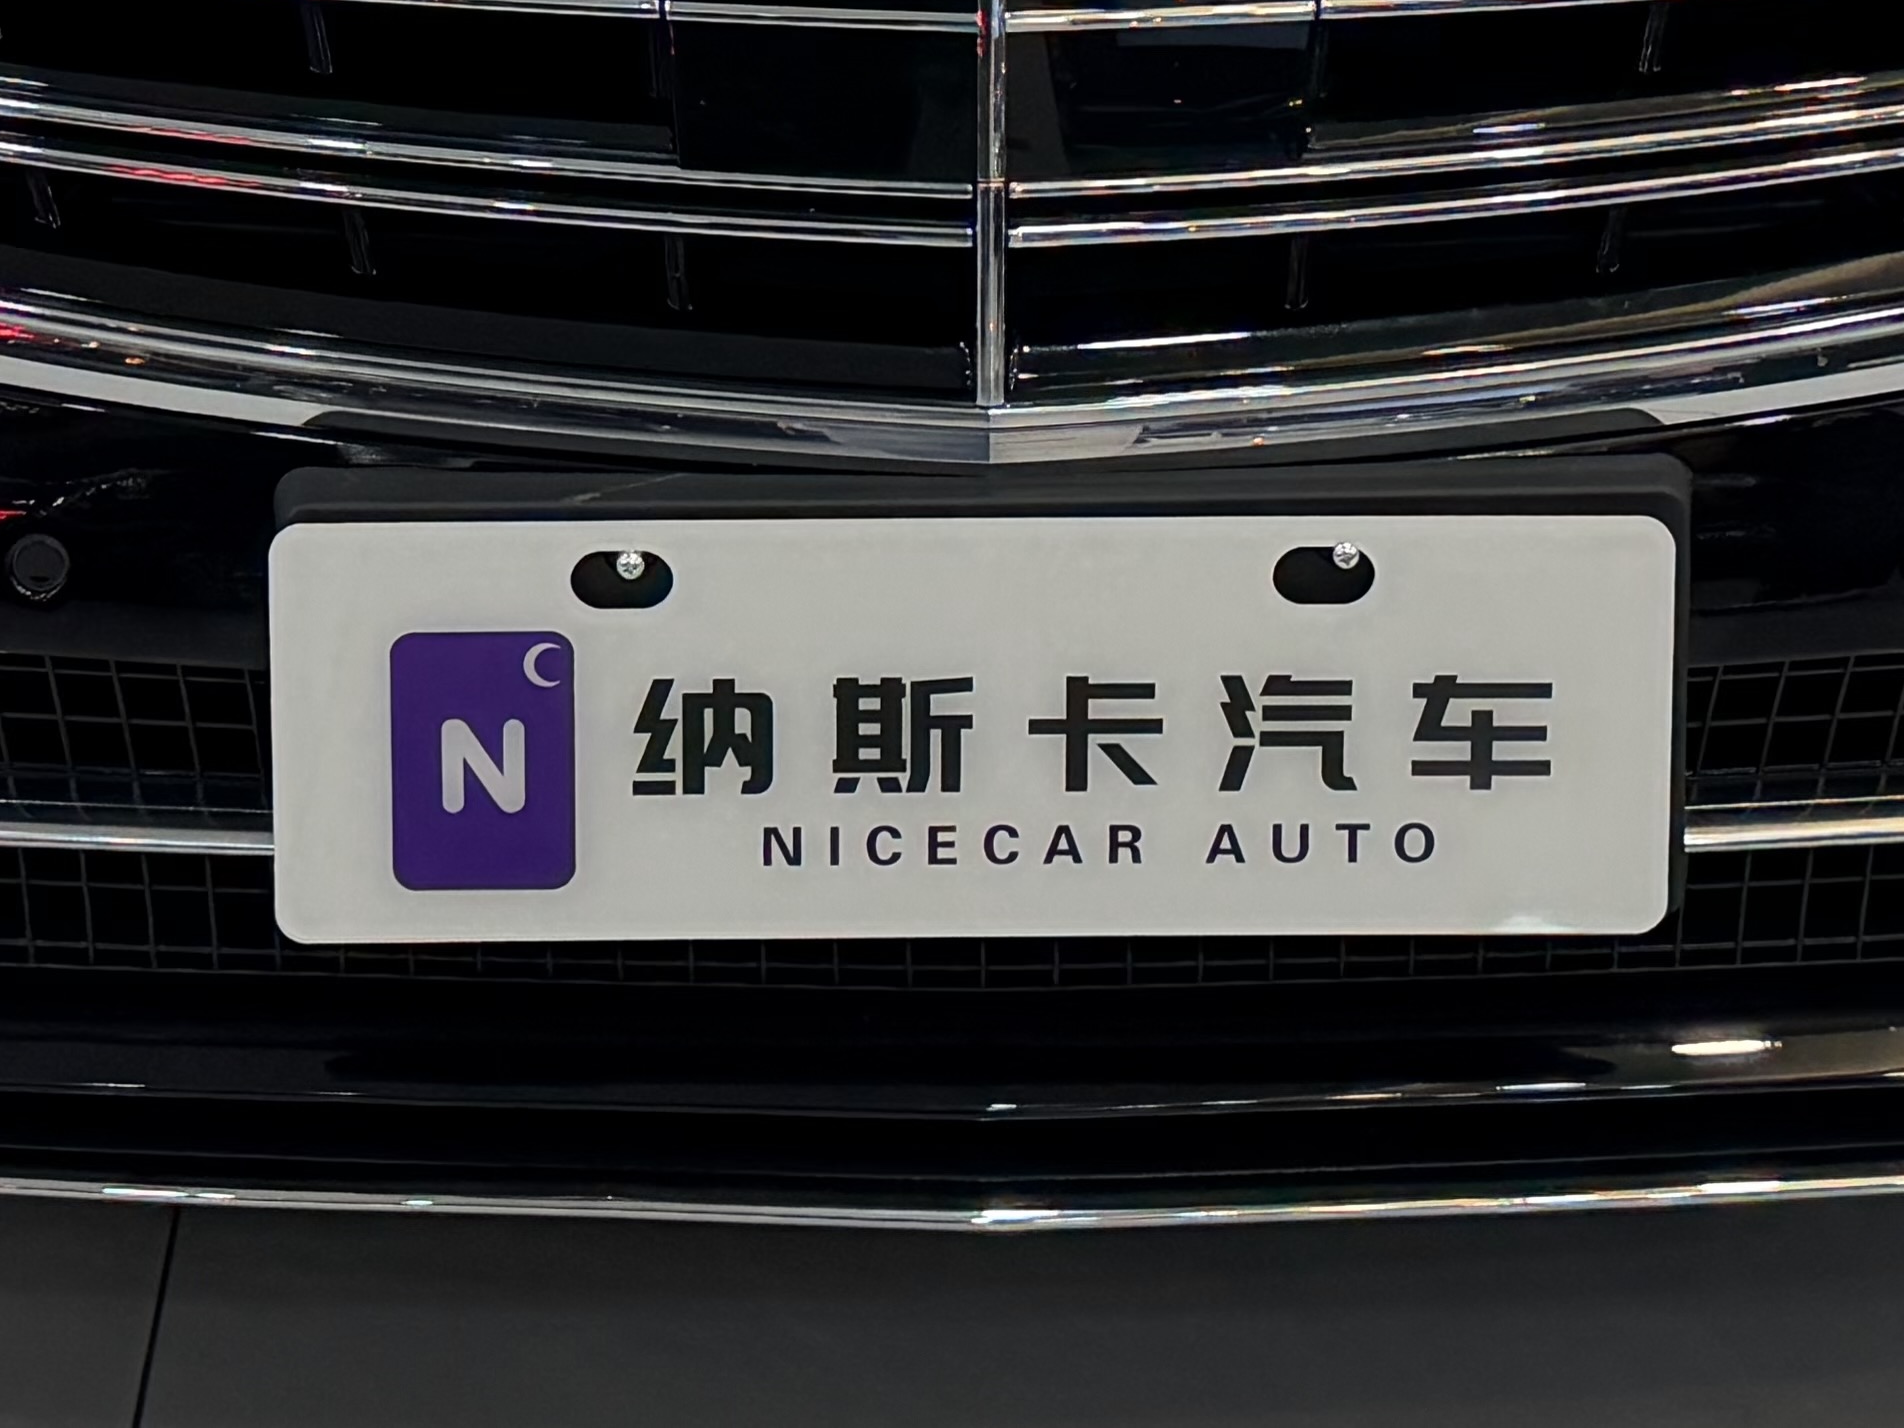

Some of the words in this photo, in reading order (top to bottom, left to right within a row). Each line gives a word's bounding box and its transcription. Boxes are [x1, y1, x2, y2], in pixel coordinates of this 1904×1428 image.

[441, 718, 526, 815] N
[632, 674, 1554, 797] 纳斯卡汽车
[762, 824, 1144, 867] NICECAR
[1205, 822, 1438, 865] AUTO
